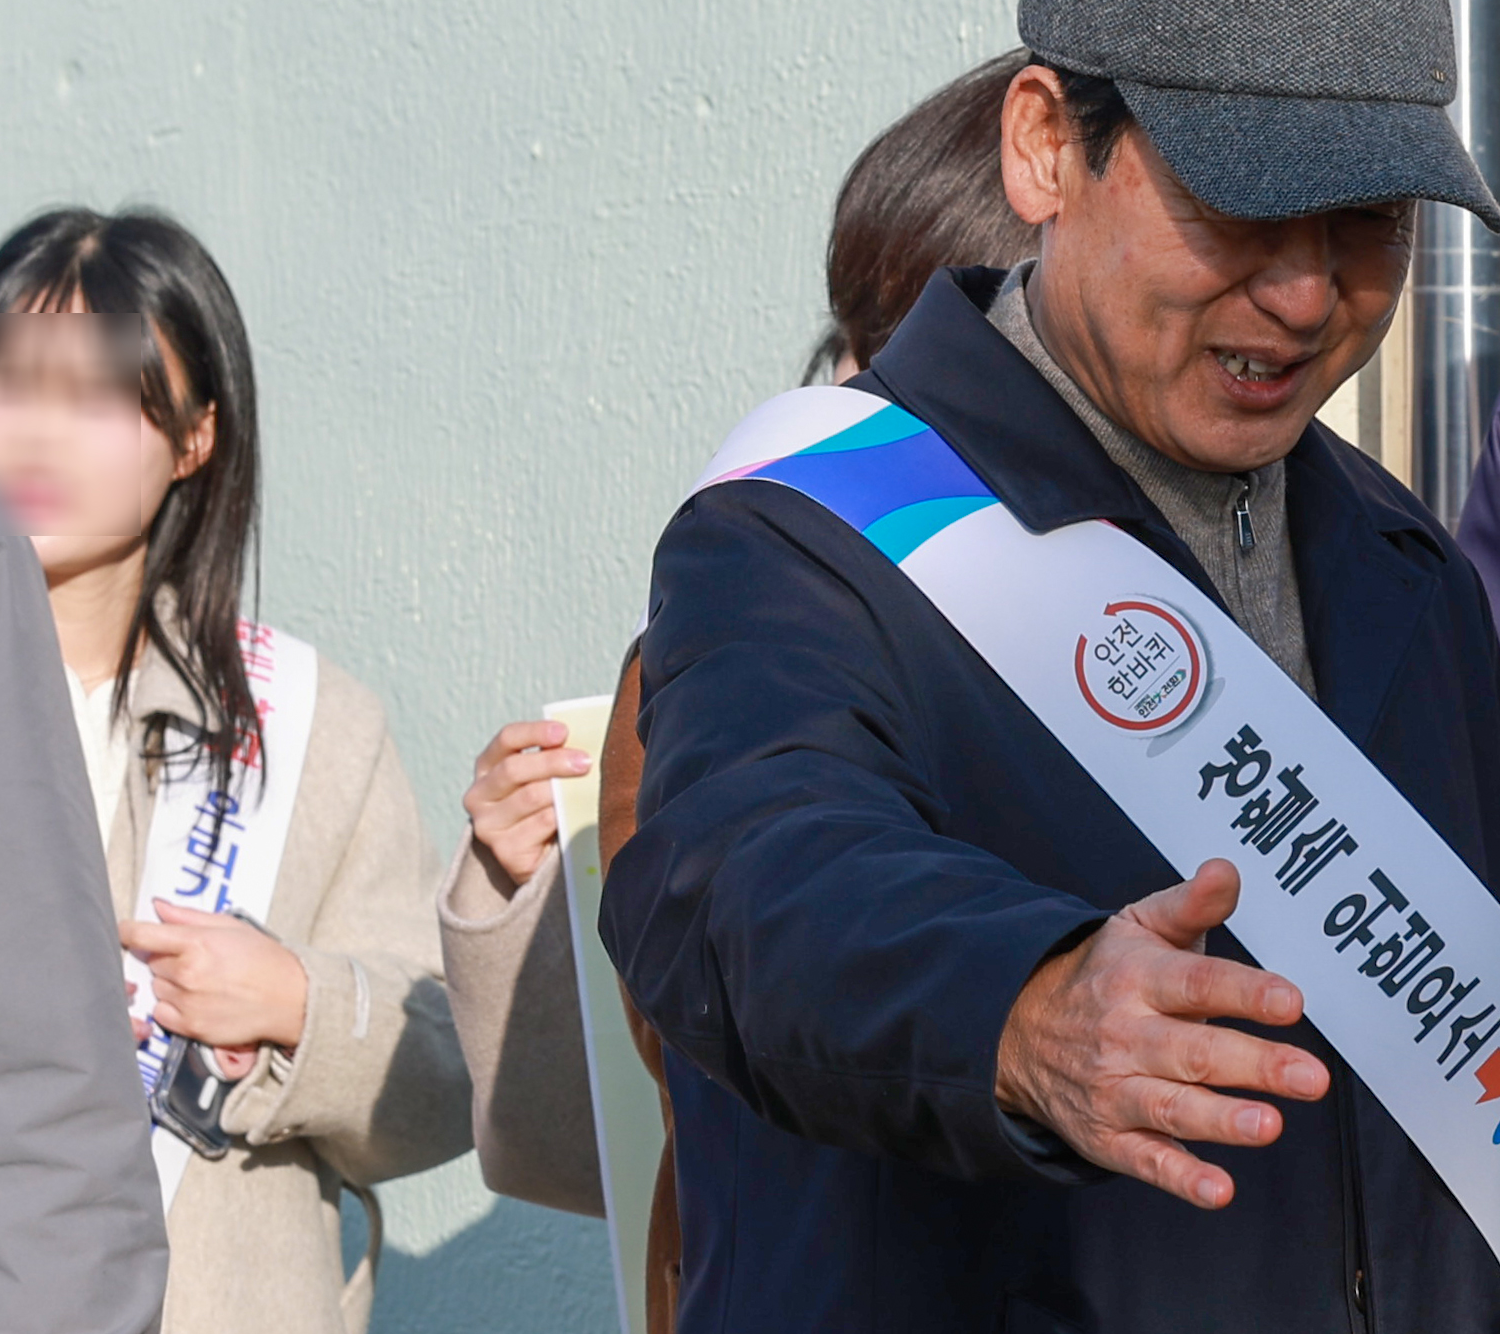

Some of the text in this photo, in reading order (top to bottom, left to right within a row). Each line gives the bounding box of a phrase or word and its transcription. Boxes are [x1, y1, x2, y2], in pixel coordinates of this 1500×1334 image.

[1093, 617, 1144, 667] 안전
[1107, 631, 1175, 701] 한바퀴
[1196, 722, 1360, 898] 생활속
